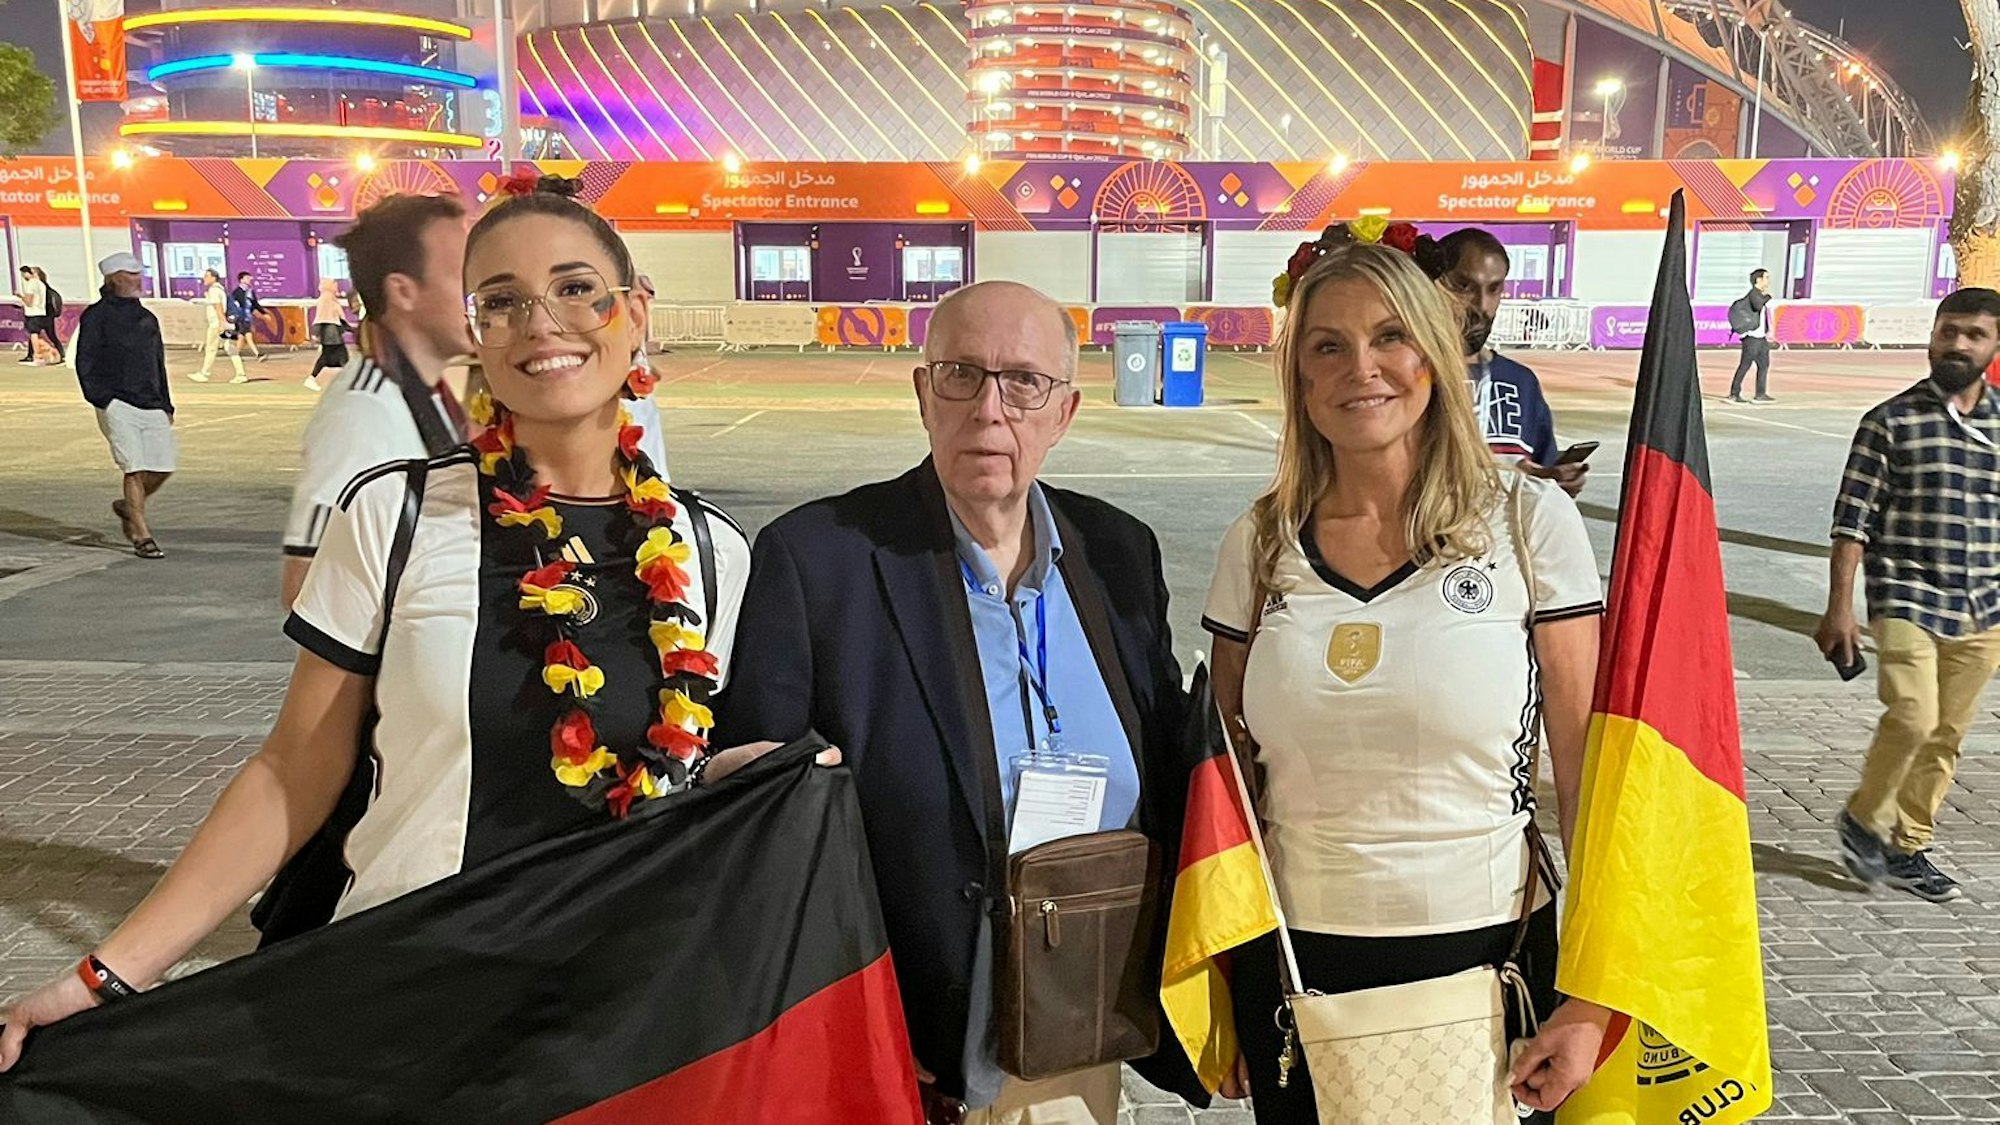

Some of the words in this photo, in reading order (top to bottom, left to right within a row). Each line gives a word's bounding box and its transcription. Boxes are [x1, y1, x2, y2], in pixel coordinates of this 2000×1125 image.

[702, 194, 782, 211] Spectator
[785, 194, 859, 208] Entrance
[1438, 194, 1519, 211] Spectator
[1522, 194, 1596, 208] Entrance
